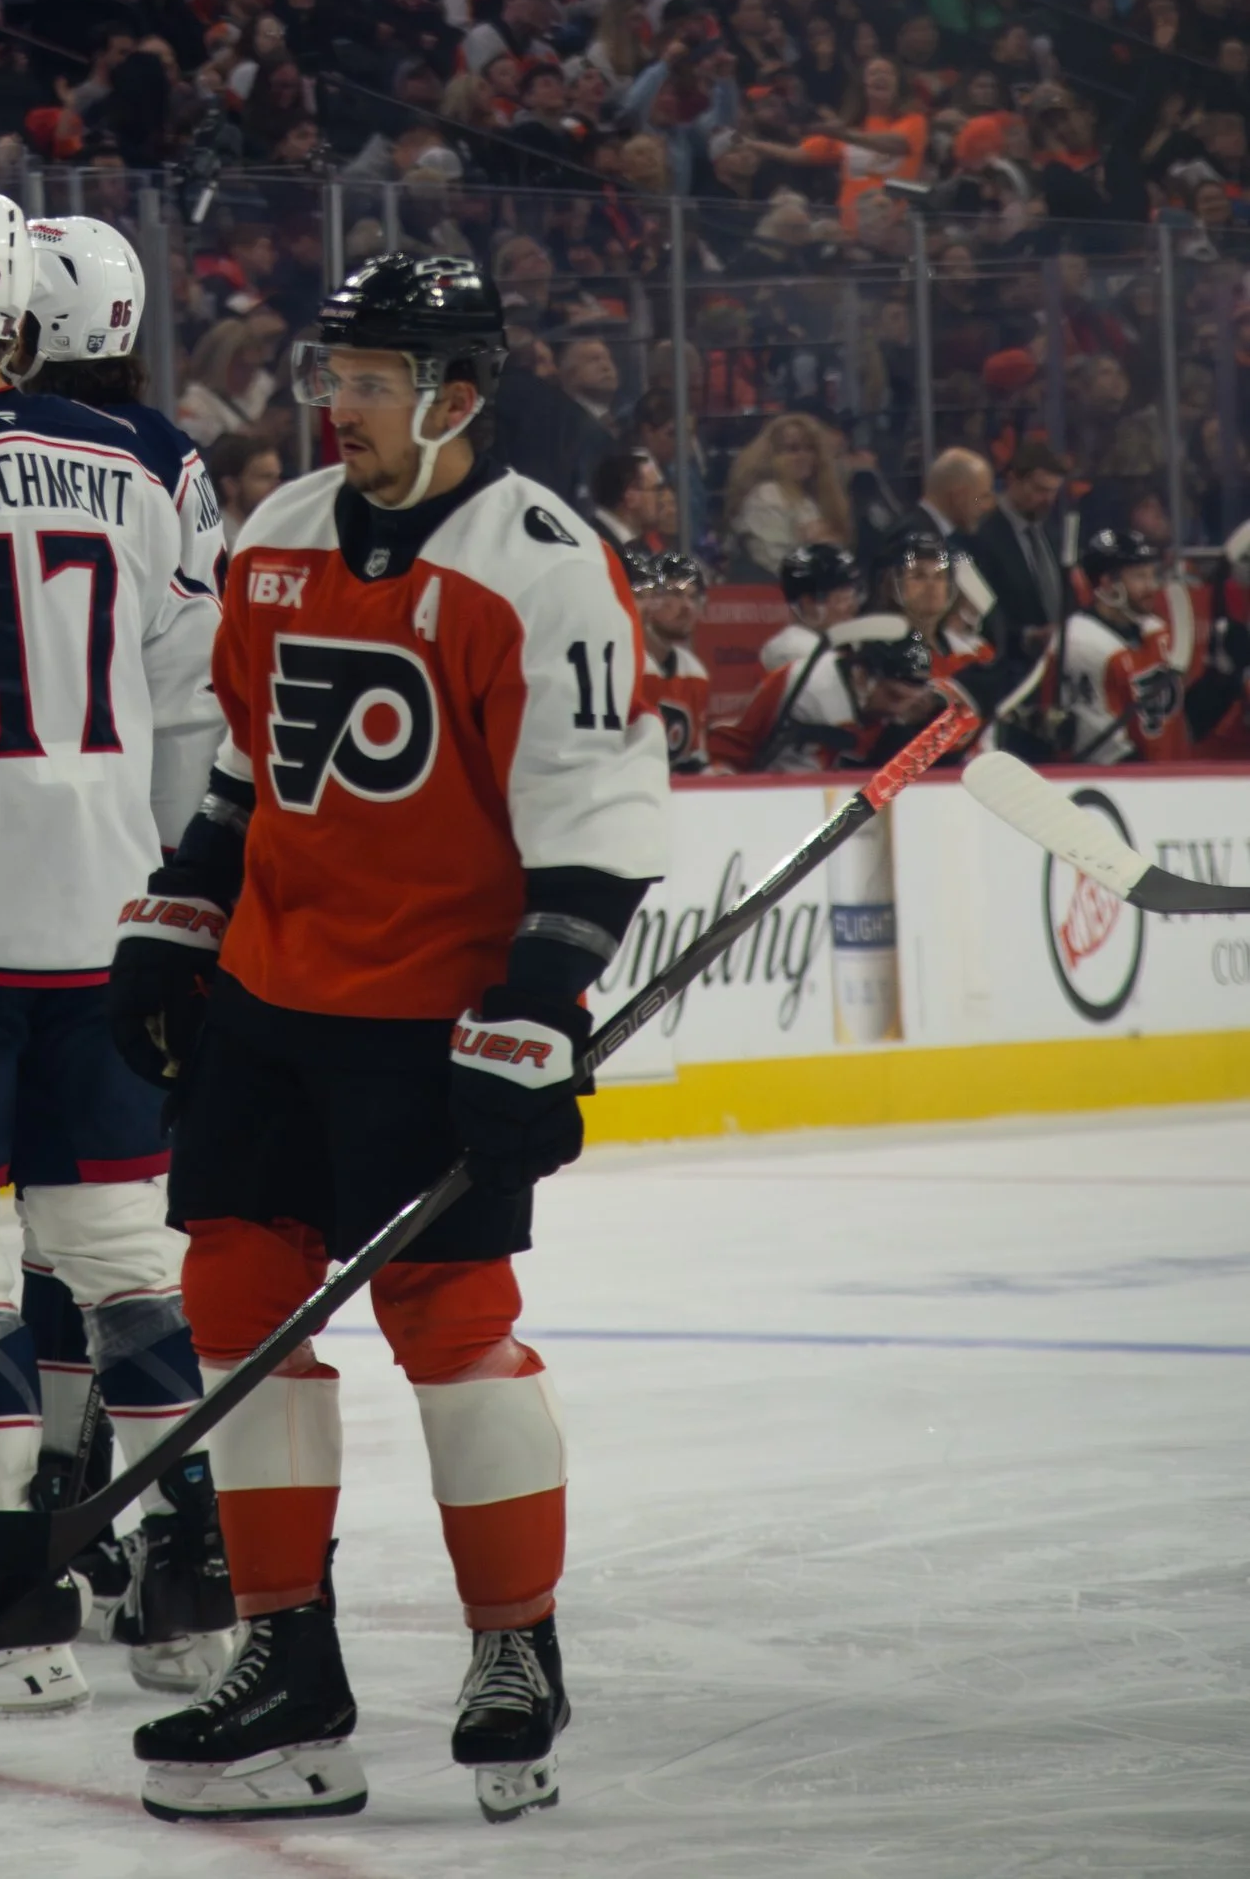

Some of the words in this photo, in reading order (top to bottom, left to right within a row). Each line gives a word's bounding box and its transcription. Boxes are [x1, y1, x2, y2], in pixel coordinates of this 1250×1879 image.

[110, 299, 133, 329] 86
[412, 575, 442, 643] A
[567, 640, 625, 730] 11
